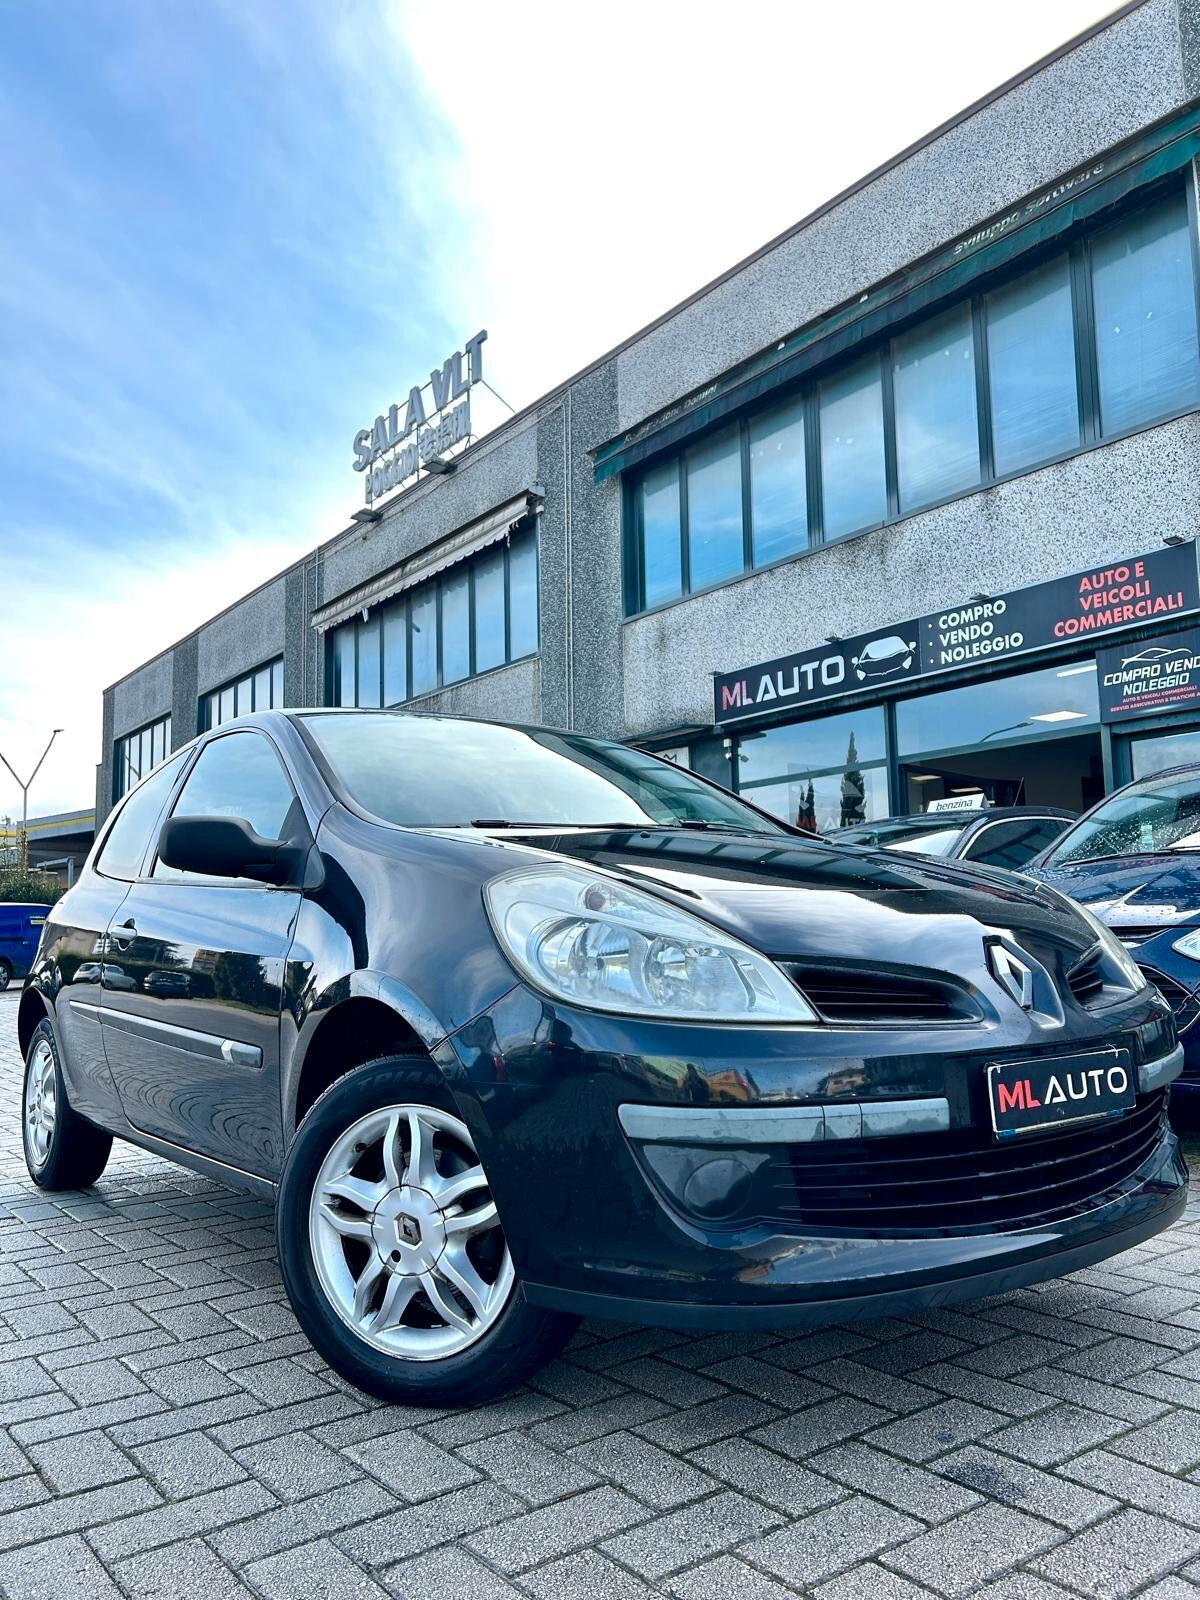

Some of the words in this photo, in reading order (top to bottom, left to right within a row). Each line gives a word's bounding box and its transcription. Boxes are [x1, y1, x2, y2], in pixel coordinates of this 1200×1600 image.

[352, 385, 426, 472] SALA
[430, 329, 488, 412] VLT
[1079, 566, 1130, 593] AUTO
[1135, 561, 1145, 577] E
[1079, 580, 1151, 611] VEICOLI
[938, 600, 1007, 630] COMPRO
[1053, 592, 1183, 637] COMMERCIALI
[939, 621, 994, 647] VENDO
[940, 632, 1024, 665] NOLEGGIO
[1103, 664, 1161, 687] COMPRO
[1123, 672, 1190, 696] NOLEGGIO
[935, 799, 973, 812] benzina
